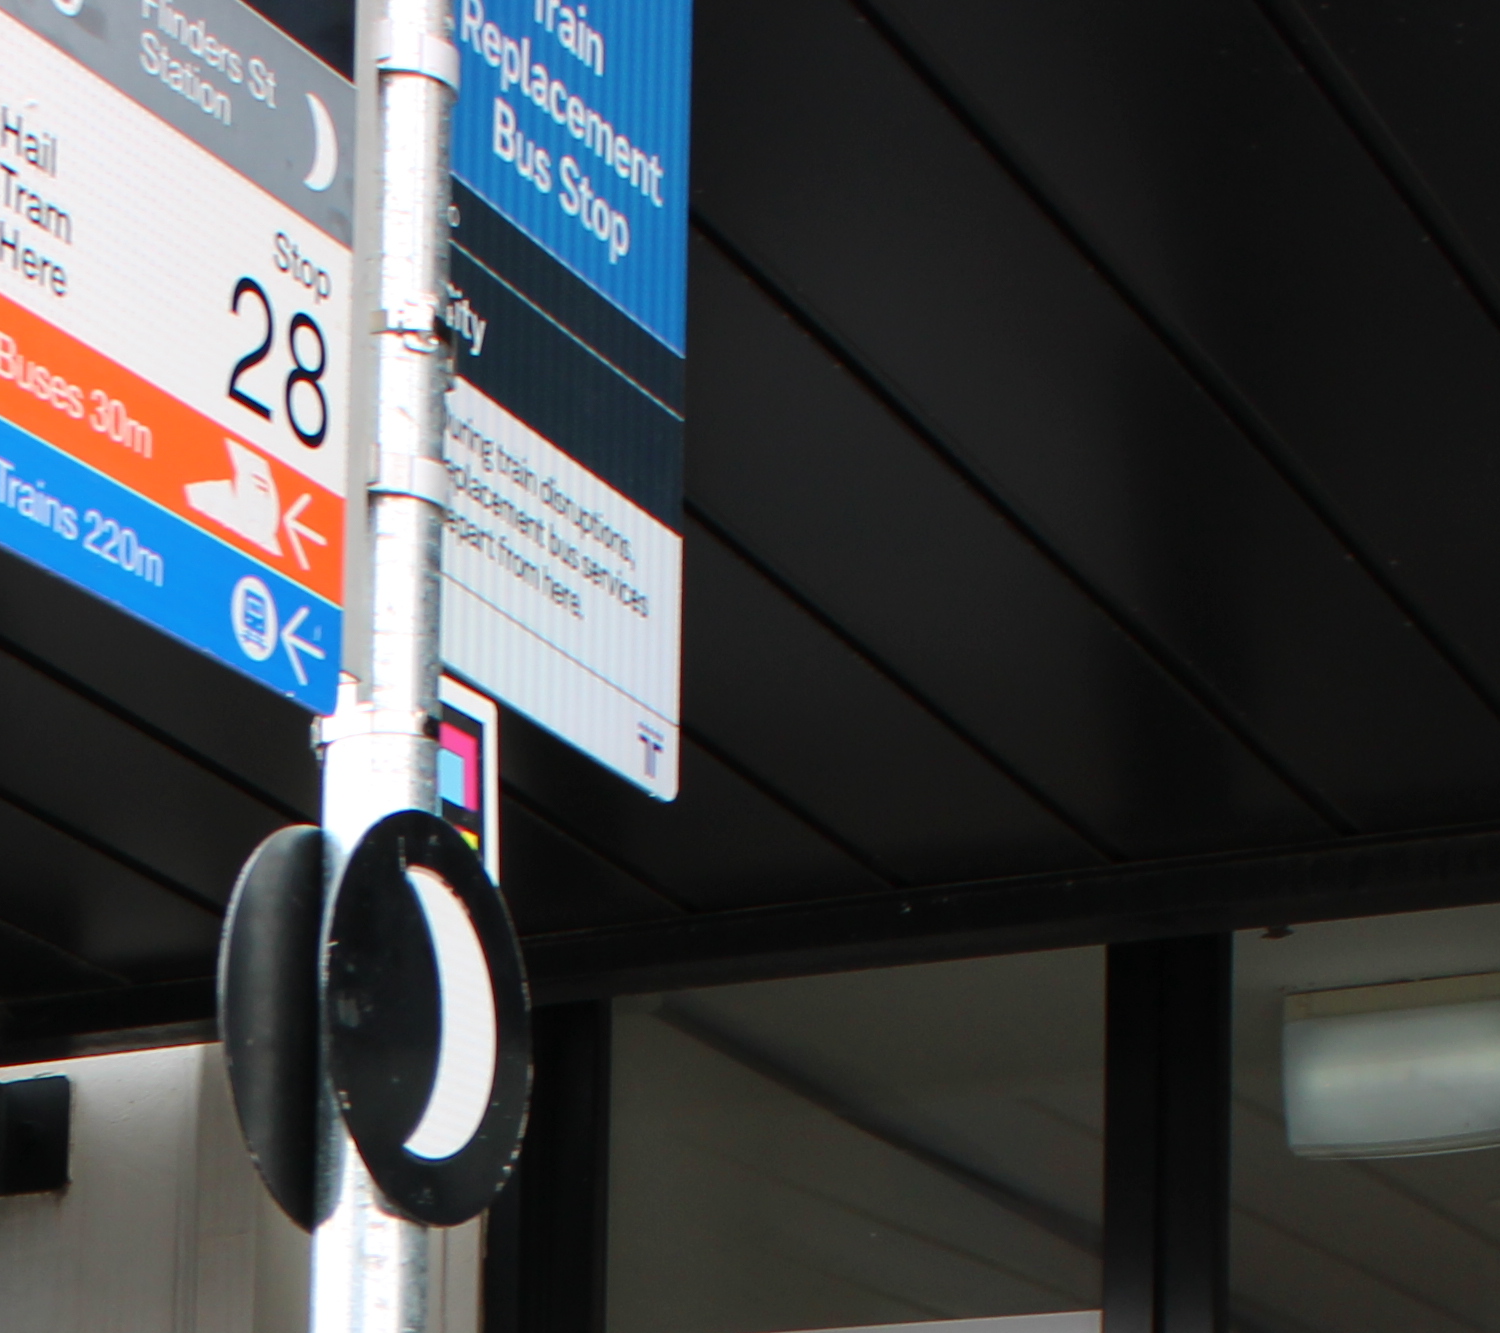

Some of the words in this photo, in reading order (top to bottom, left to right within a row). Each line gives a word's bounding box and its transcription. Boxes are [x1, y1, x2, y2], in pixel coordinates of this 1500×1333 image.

[140, 31, 232, 127] Station
[248, 58, 277, 109] St
[460, 0, 664, 208] Replacement
[0, 105, 58, 178] Hail
[492, 96, 552, 194] Bus
[558, 154, 631, 265] Stop
[273, 231, 332, 304] Stop
[227, 276, 329, 450] 28
[89, 384, 153, 459] 30m
[449, 415, 495, 473] uring
[83, 510, 165, 588] 220m
[444, 459, 545, 548] eplacement
[548, 523, 580, 570] bus
[444, 509, 496, 560] epart
[497, 535, 540, 592] from
